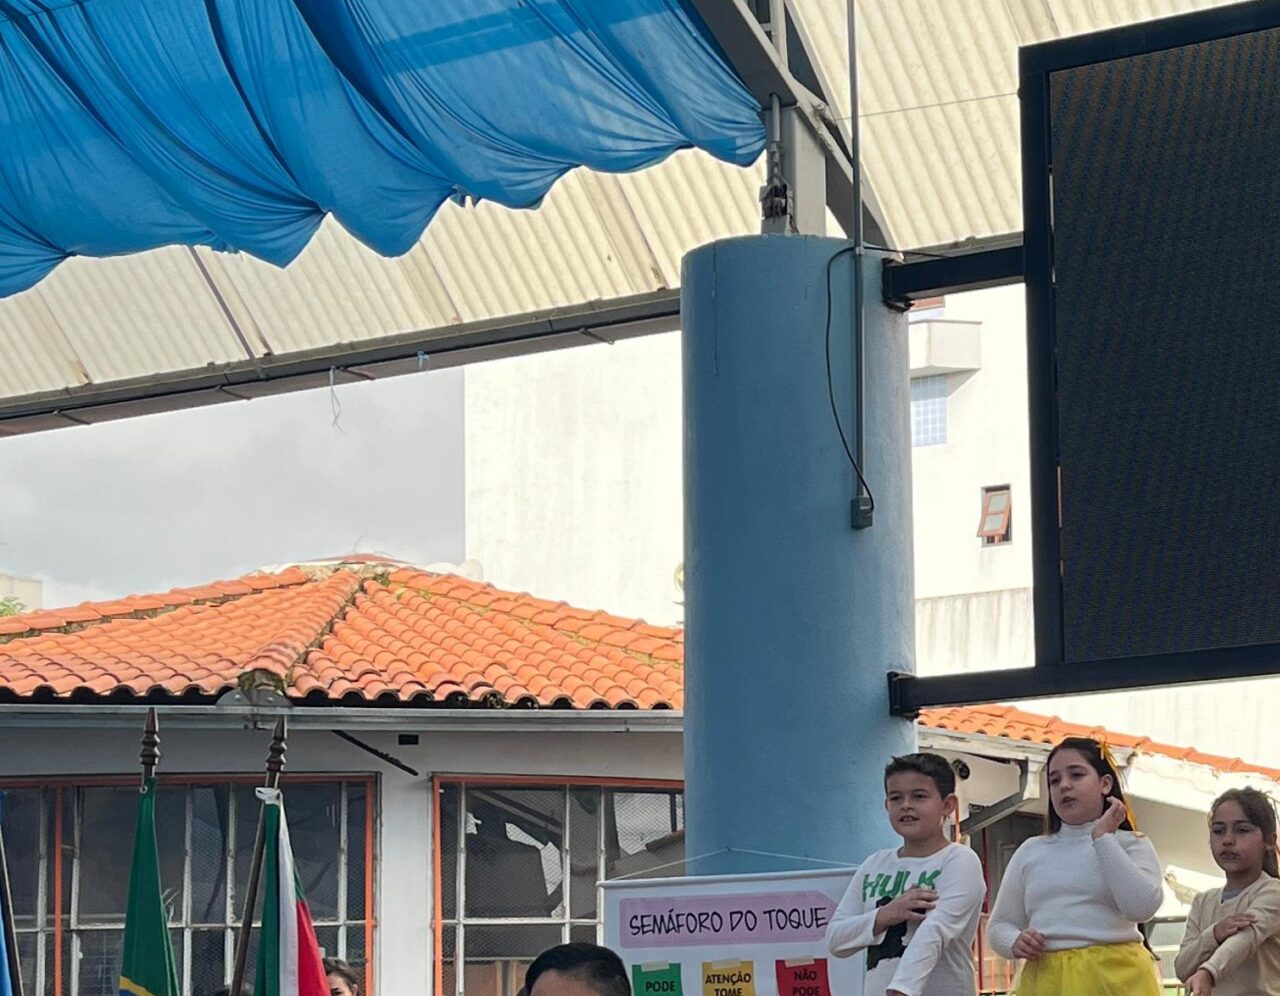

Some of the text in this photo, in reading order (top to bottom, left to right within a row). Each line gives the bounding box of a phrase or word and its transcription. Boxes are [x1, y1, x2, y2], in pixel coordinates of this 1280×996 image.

[629, 907, 829, 935] SEMÁFORO DO TOQUE
[705, 970, 752, 986] ATENÇÃO
[794, 968, 817, 981] NÃO
[645, 980, 676, 993] PODE
[792, 986, 821, 996] PODE
